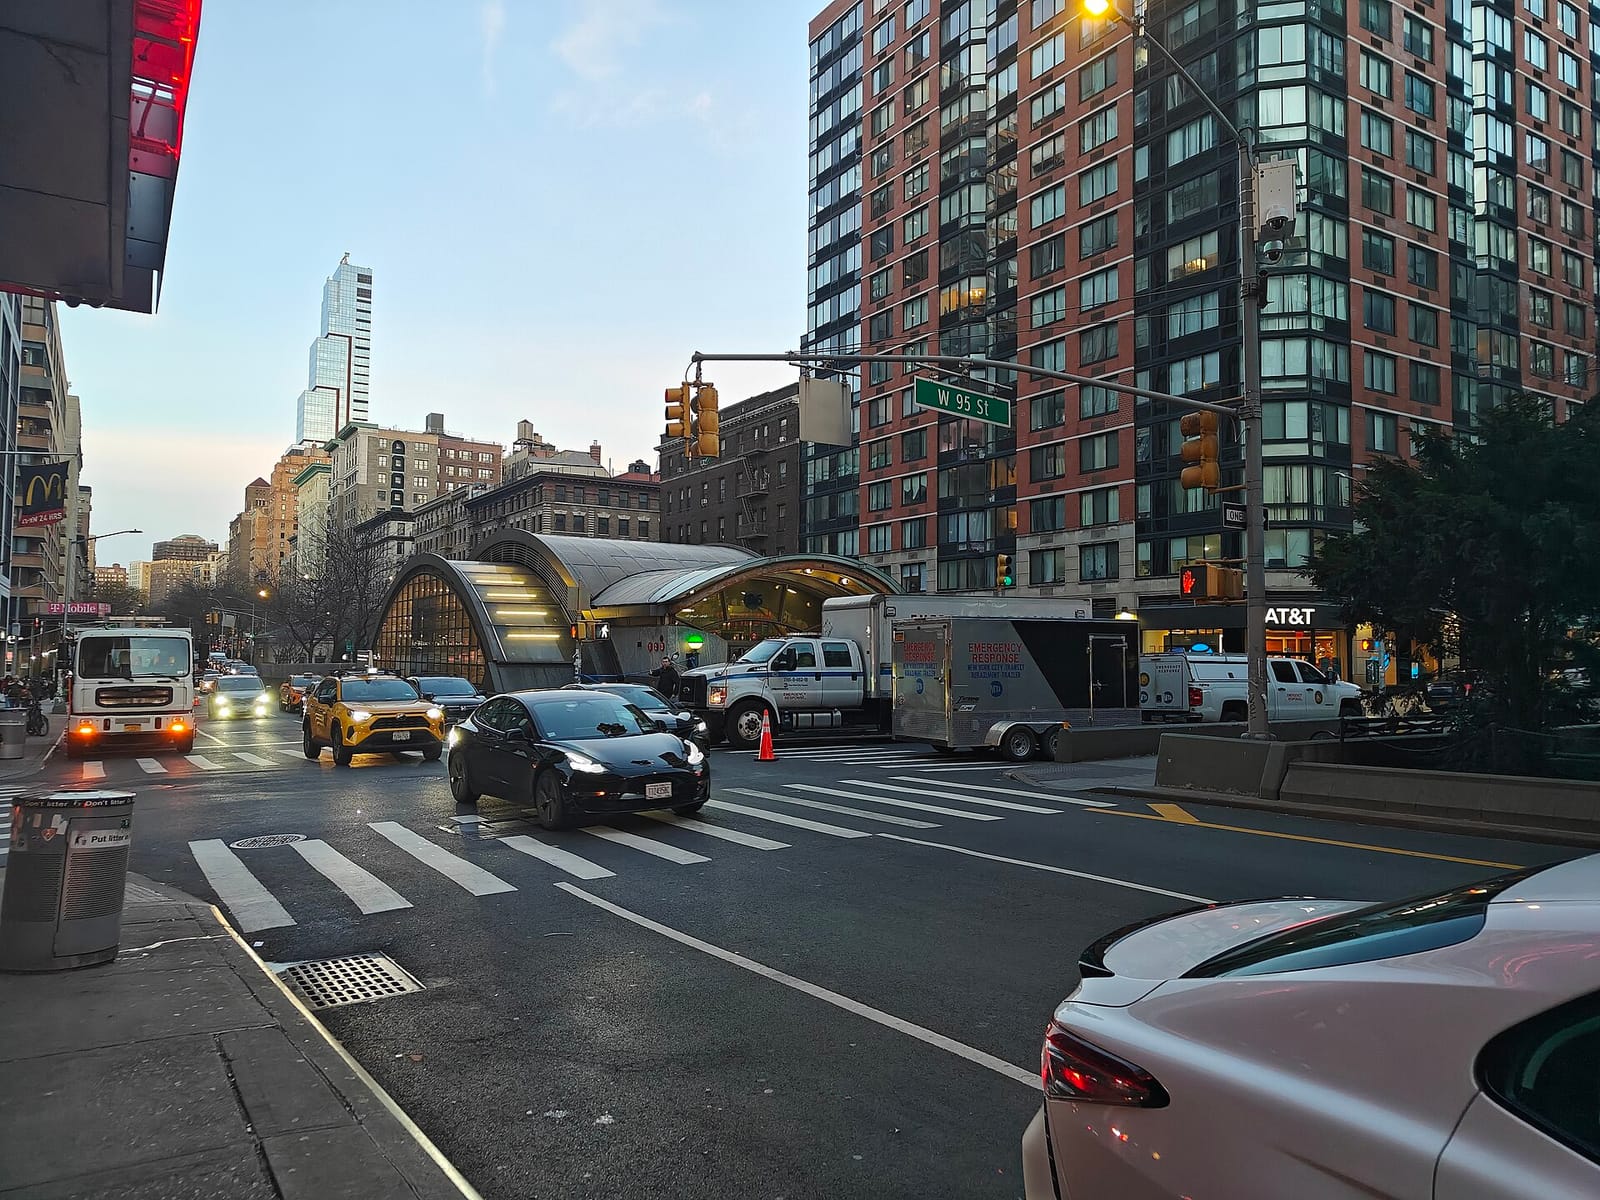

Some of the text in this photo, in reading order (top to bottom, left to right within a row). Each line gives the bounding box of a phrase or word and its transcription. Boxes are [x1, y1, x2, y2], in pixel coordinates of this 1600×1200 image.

[937, 389, 989, 417] W 95 St
[39, 514, 48, 522] 24
[48, 512, 62, 521] HRS
[1229, 510, 1244, 521] ONE
[1264, 608, 1315, 625] AT&T
[968, 643, 1023, 653] EMERGENCY
[972, 653, 1020, 663] RESPONSE
[91, 835, 106, 843] Put
[108, 834, 124, 842] litter
